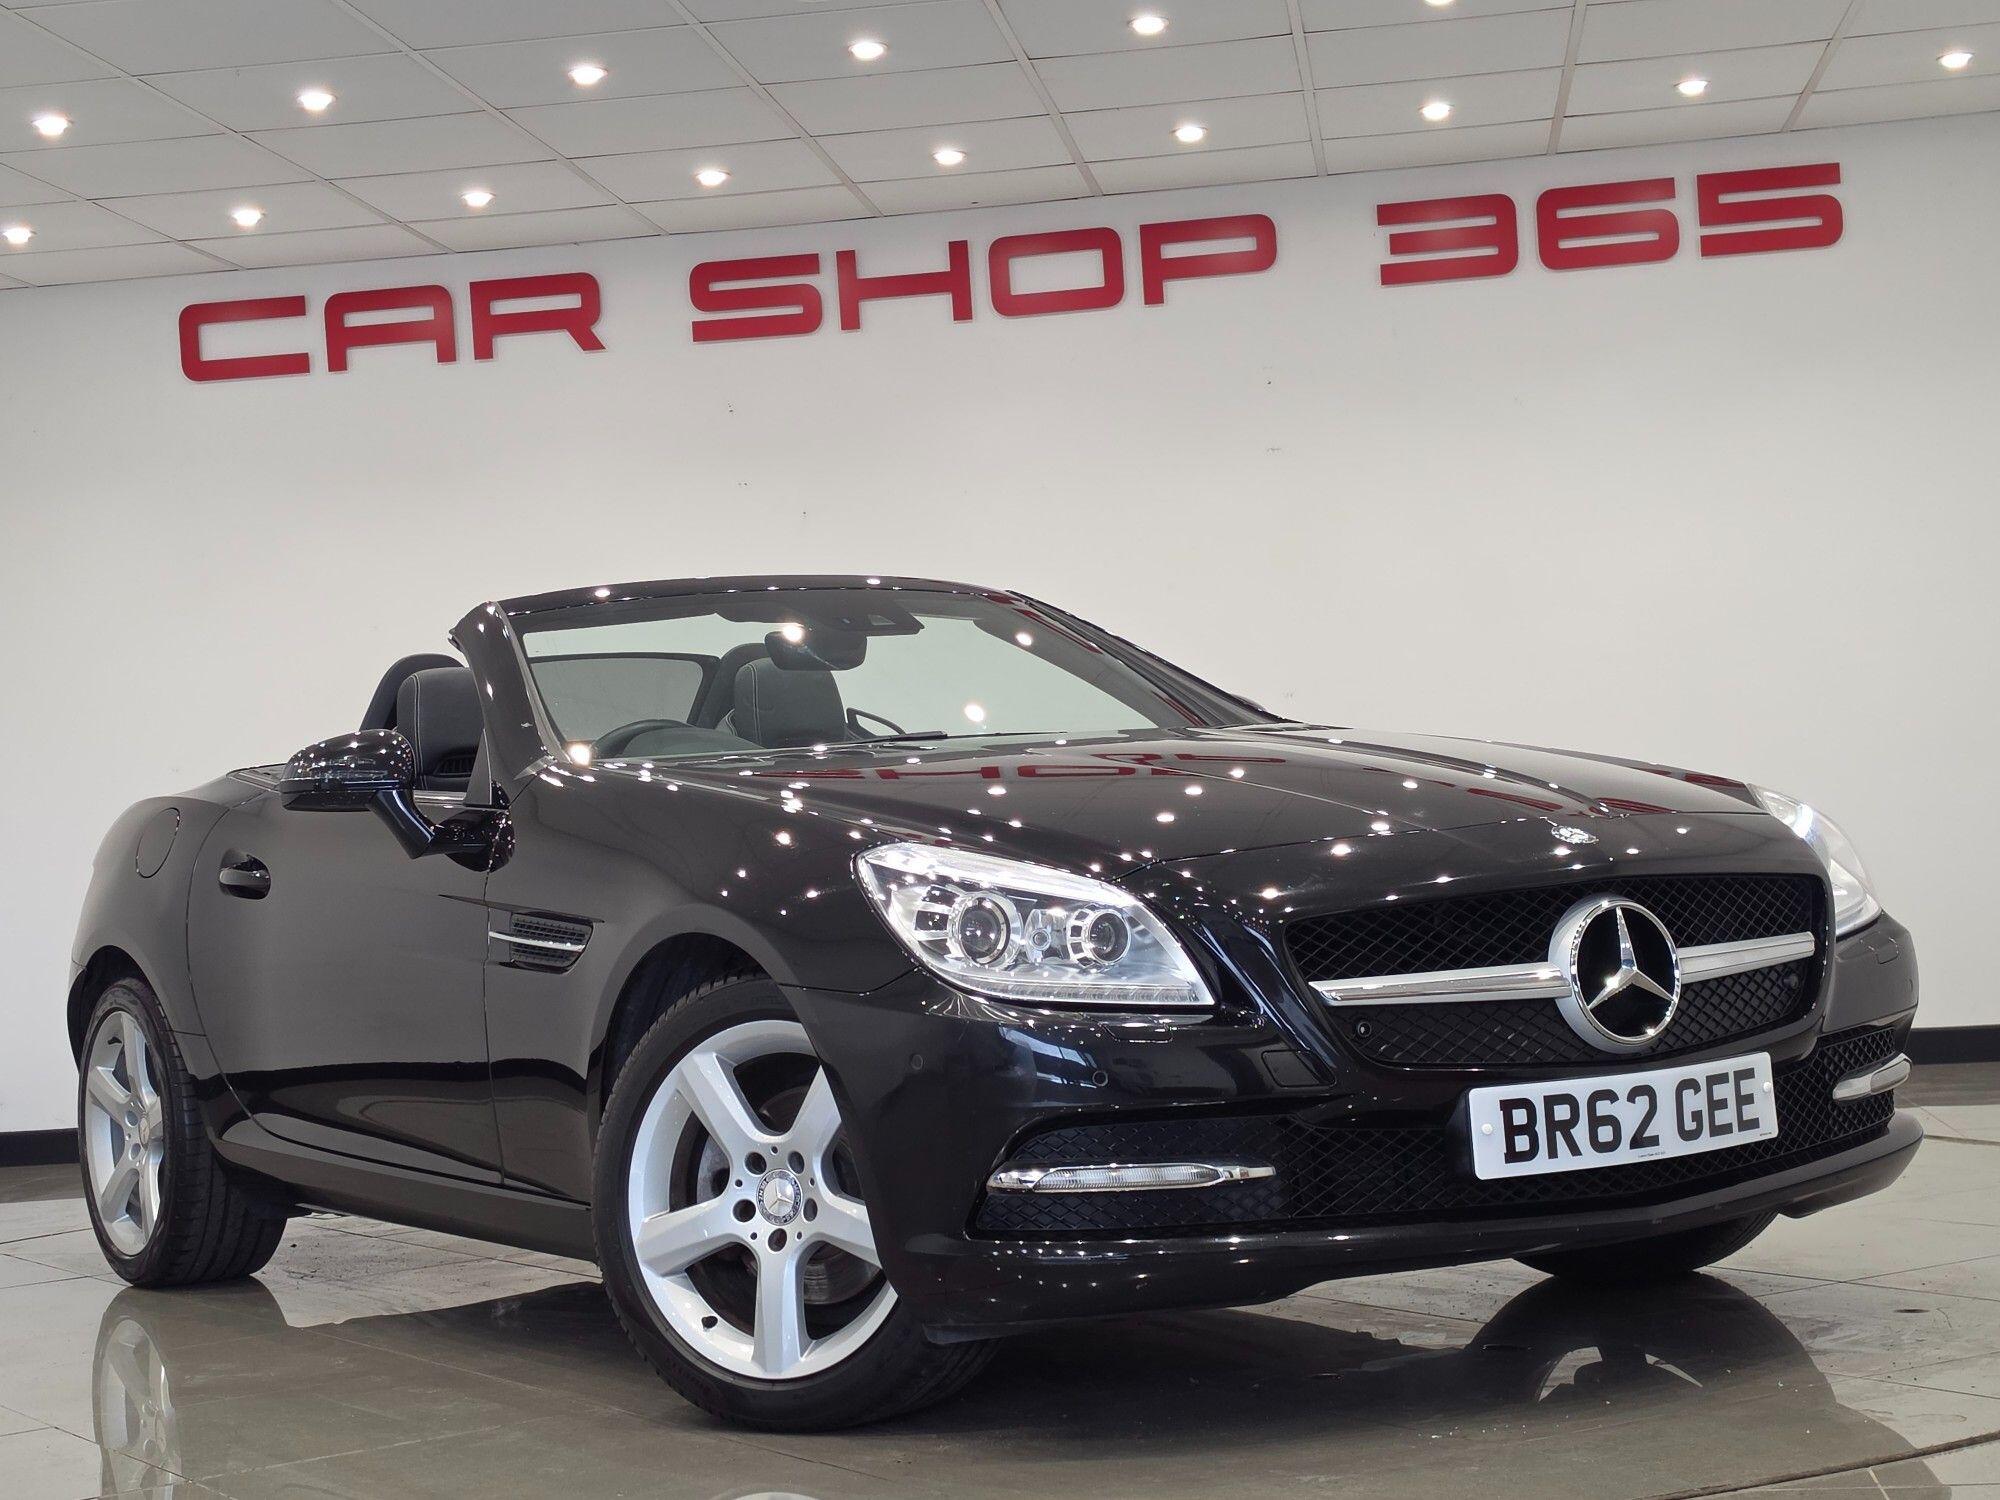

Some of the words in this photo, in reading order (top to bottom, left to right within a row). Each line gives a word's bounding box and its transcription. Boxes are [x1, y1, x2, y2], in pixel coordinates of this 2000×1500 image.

[180, 272, 604, 382] CAR
[689, 215, 1277, 343] SHOP
[1376, 163, 1844, 286] 365
[1499, 1084, 1660, 1164] BR62
[1675, 1067, 1760, 1142] GEE
